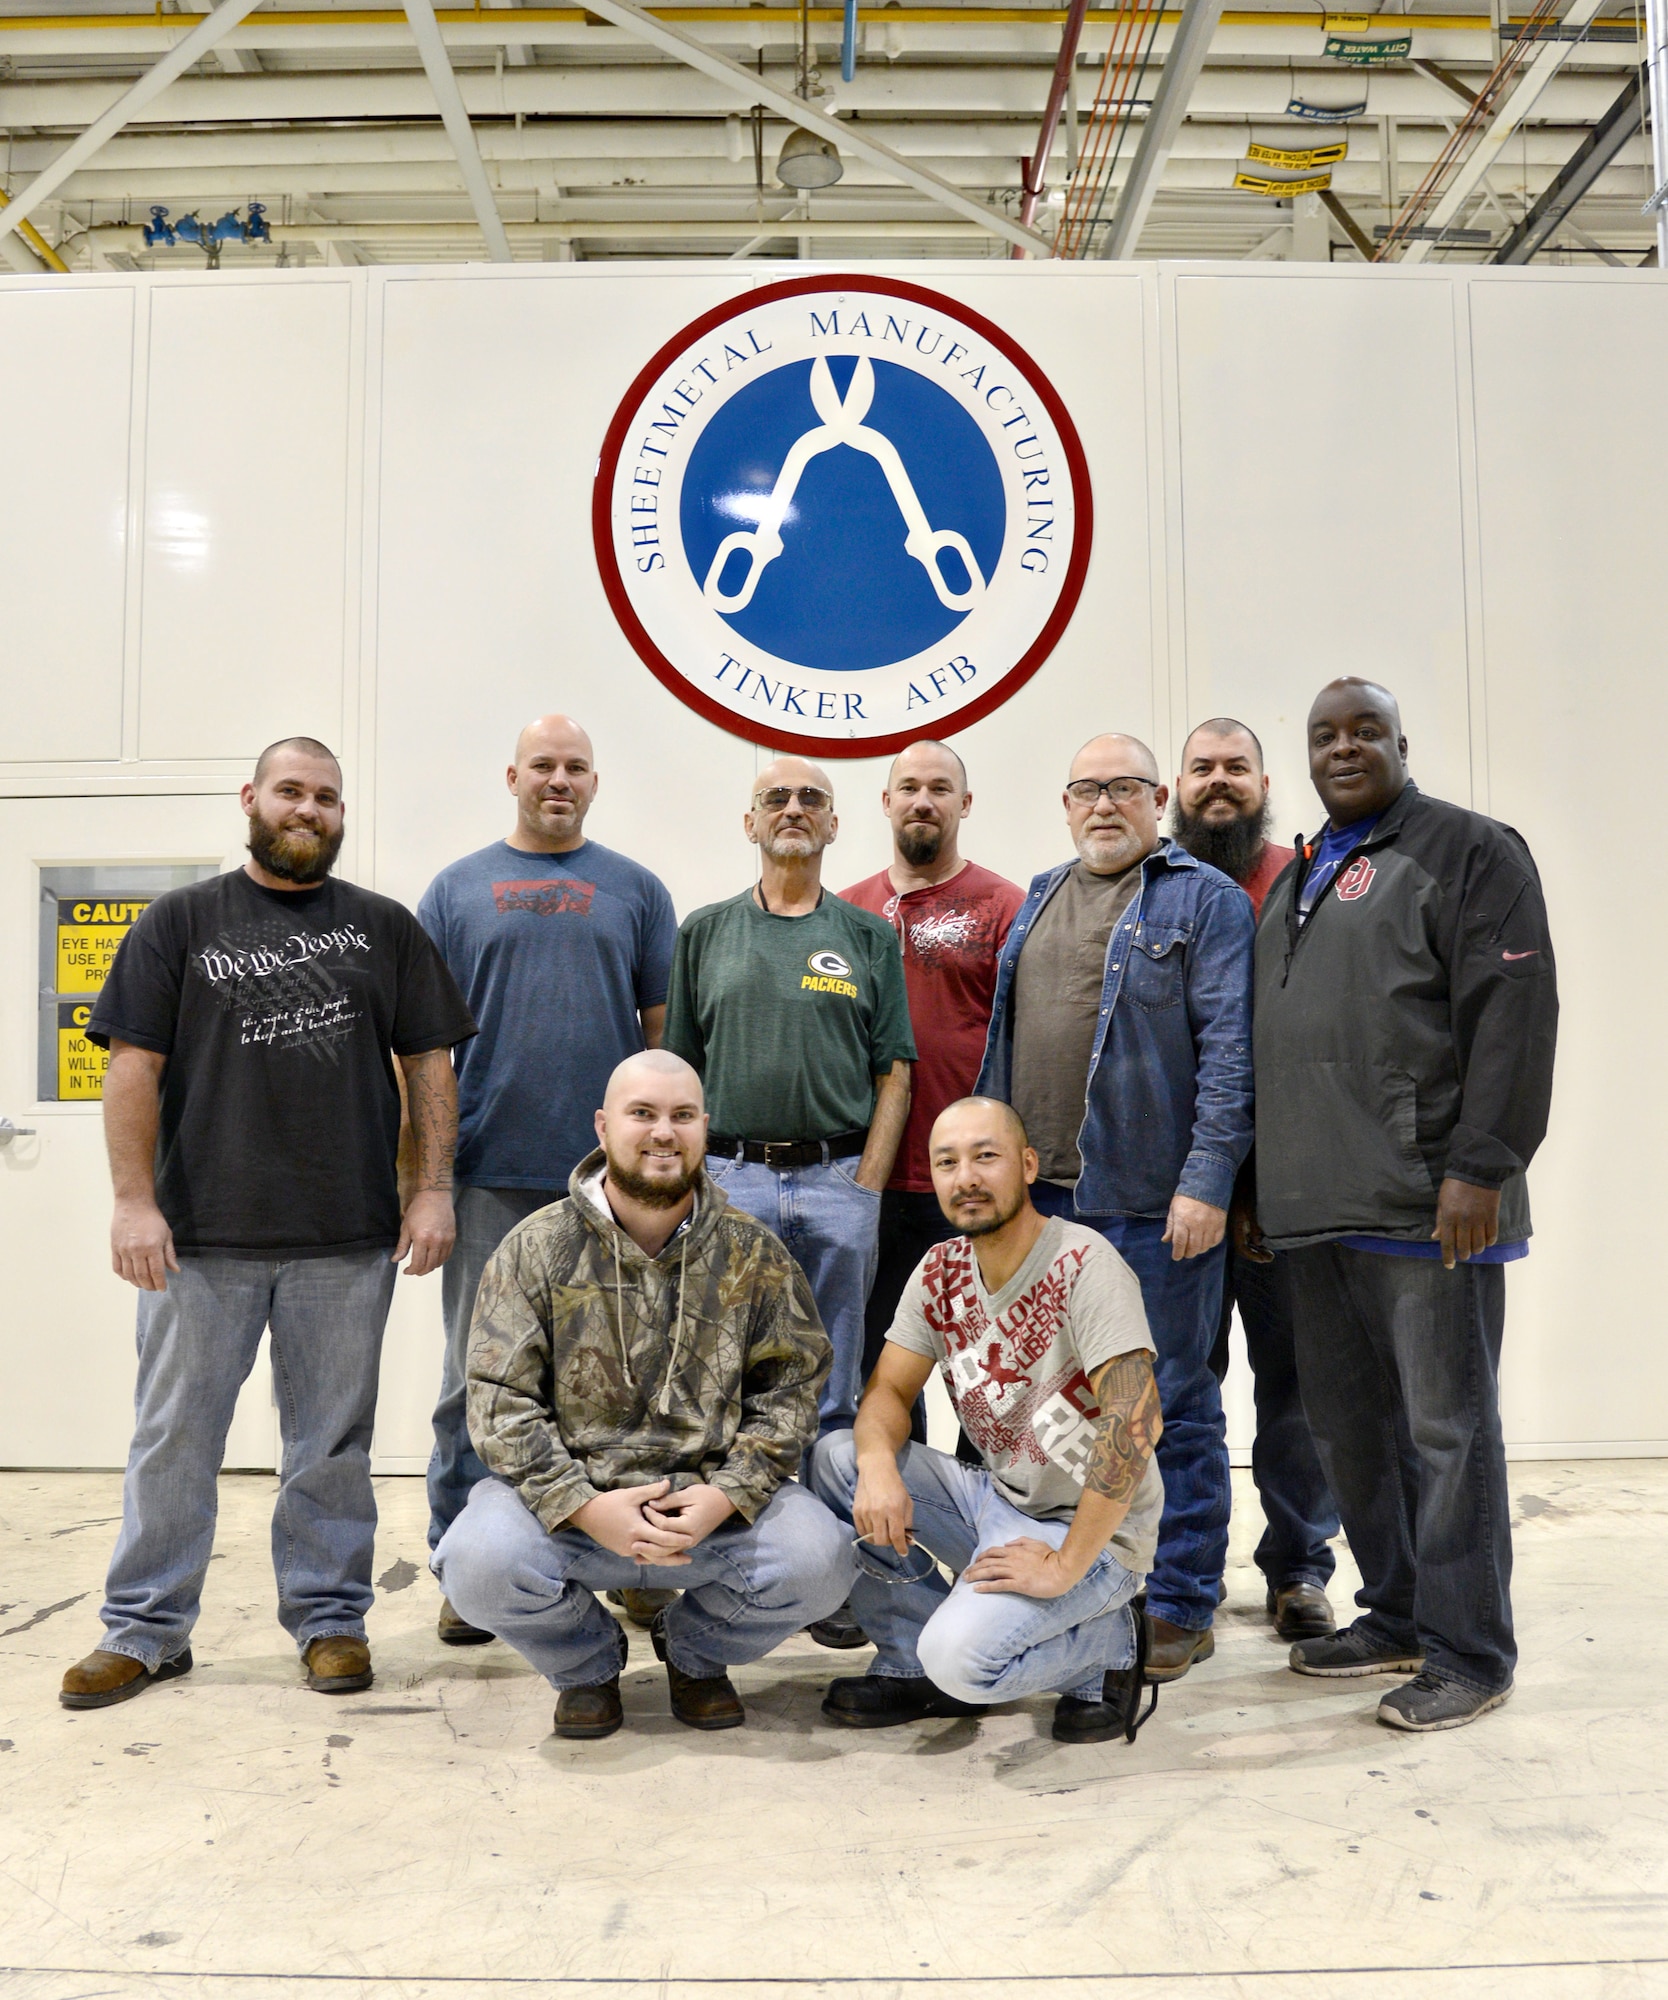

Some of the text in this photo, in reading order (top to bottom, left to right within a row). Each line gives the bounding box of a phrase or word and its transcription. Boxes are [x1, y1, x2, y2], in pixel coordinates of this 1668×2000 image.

[1343, 43, 1408, 53] CITY WATER
[631, 309, 1054, 575] SHEETMETAL MANUFACTURING
[713, 652, 978, 721] TINKER AFB
[62, 938, 89, 950] EYE
[68, 953, 96, 965] USE
[199, 948, 251, 987] We
[285, 923, 372, 972] People
[800, 974, 858, 999] PACKERS
[72, 1006, 90, 1026] C
[69, 1039, 86, 1053] NO
[67, 1057, 110, 1070] WILL B
[70, 1075, 104, 1089] IN TH
[995, 1244, 1092, 1340] LOYALTY
[1010, 1285, 1068, 1353] DEFENSE
